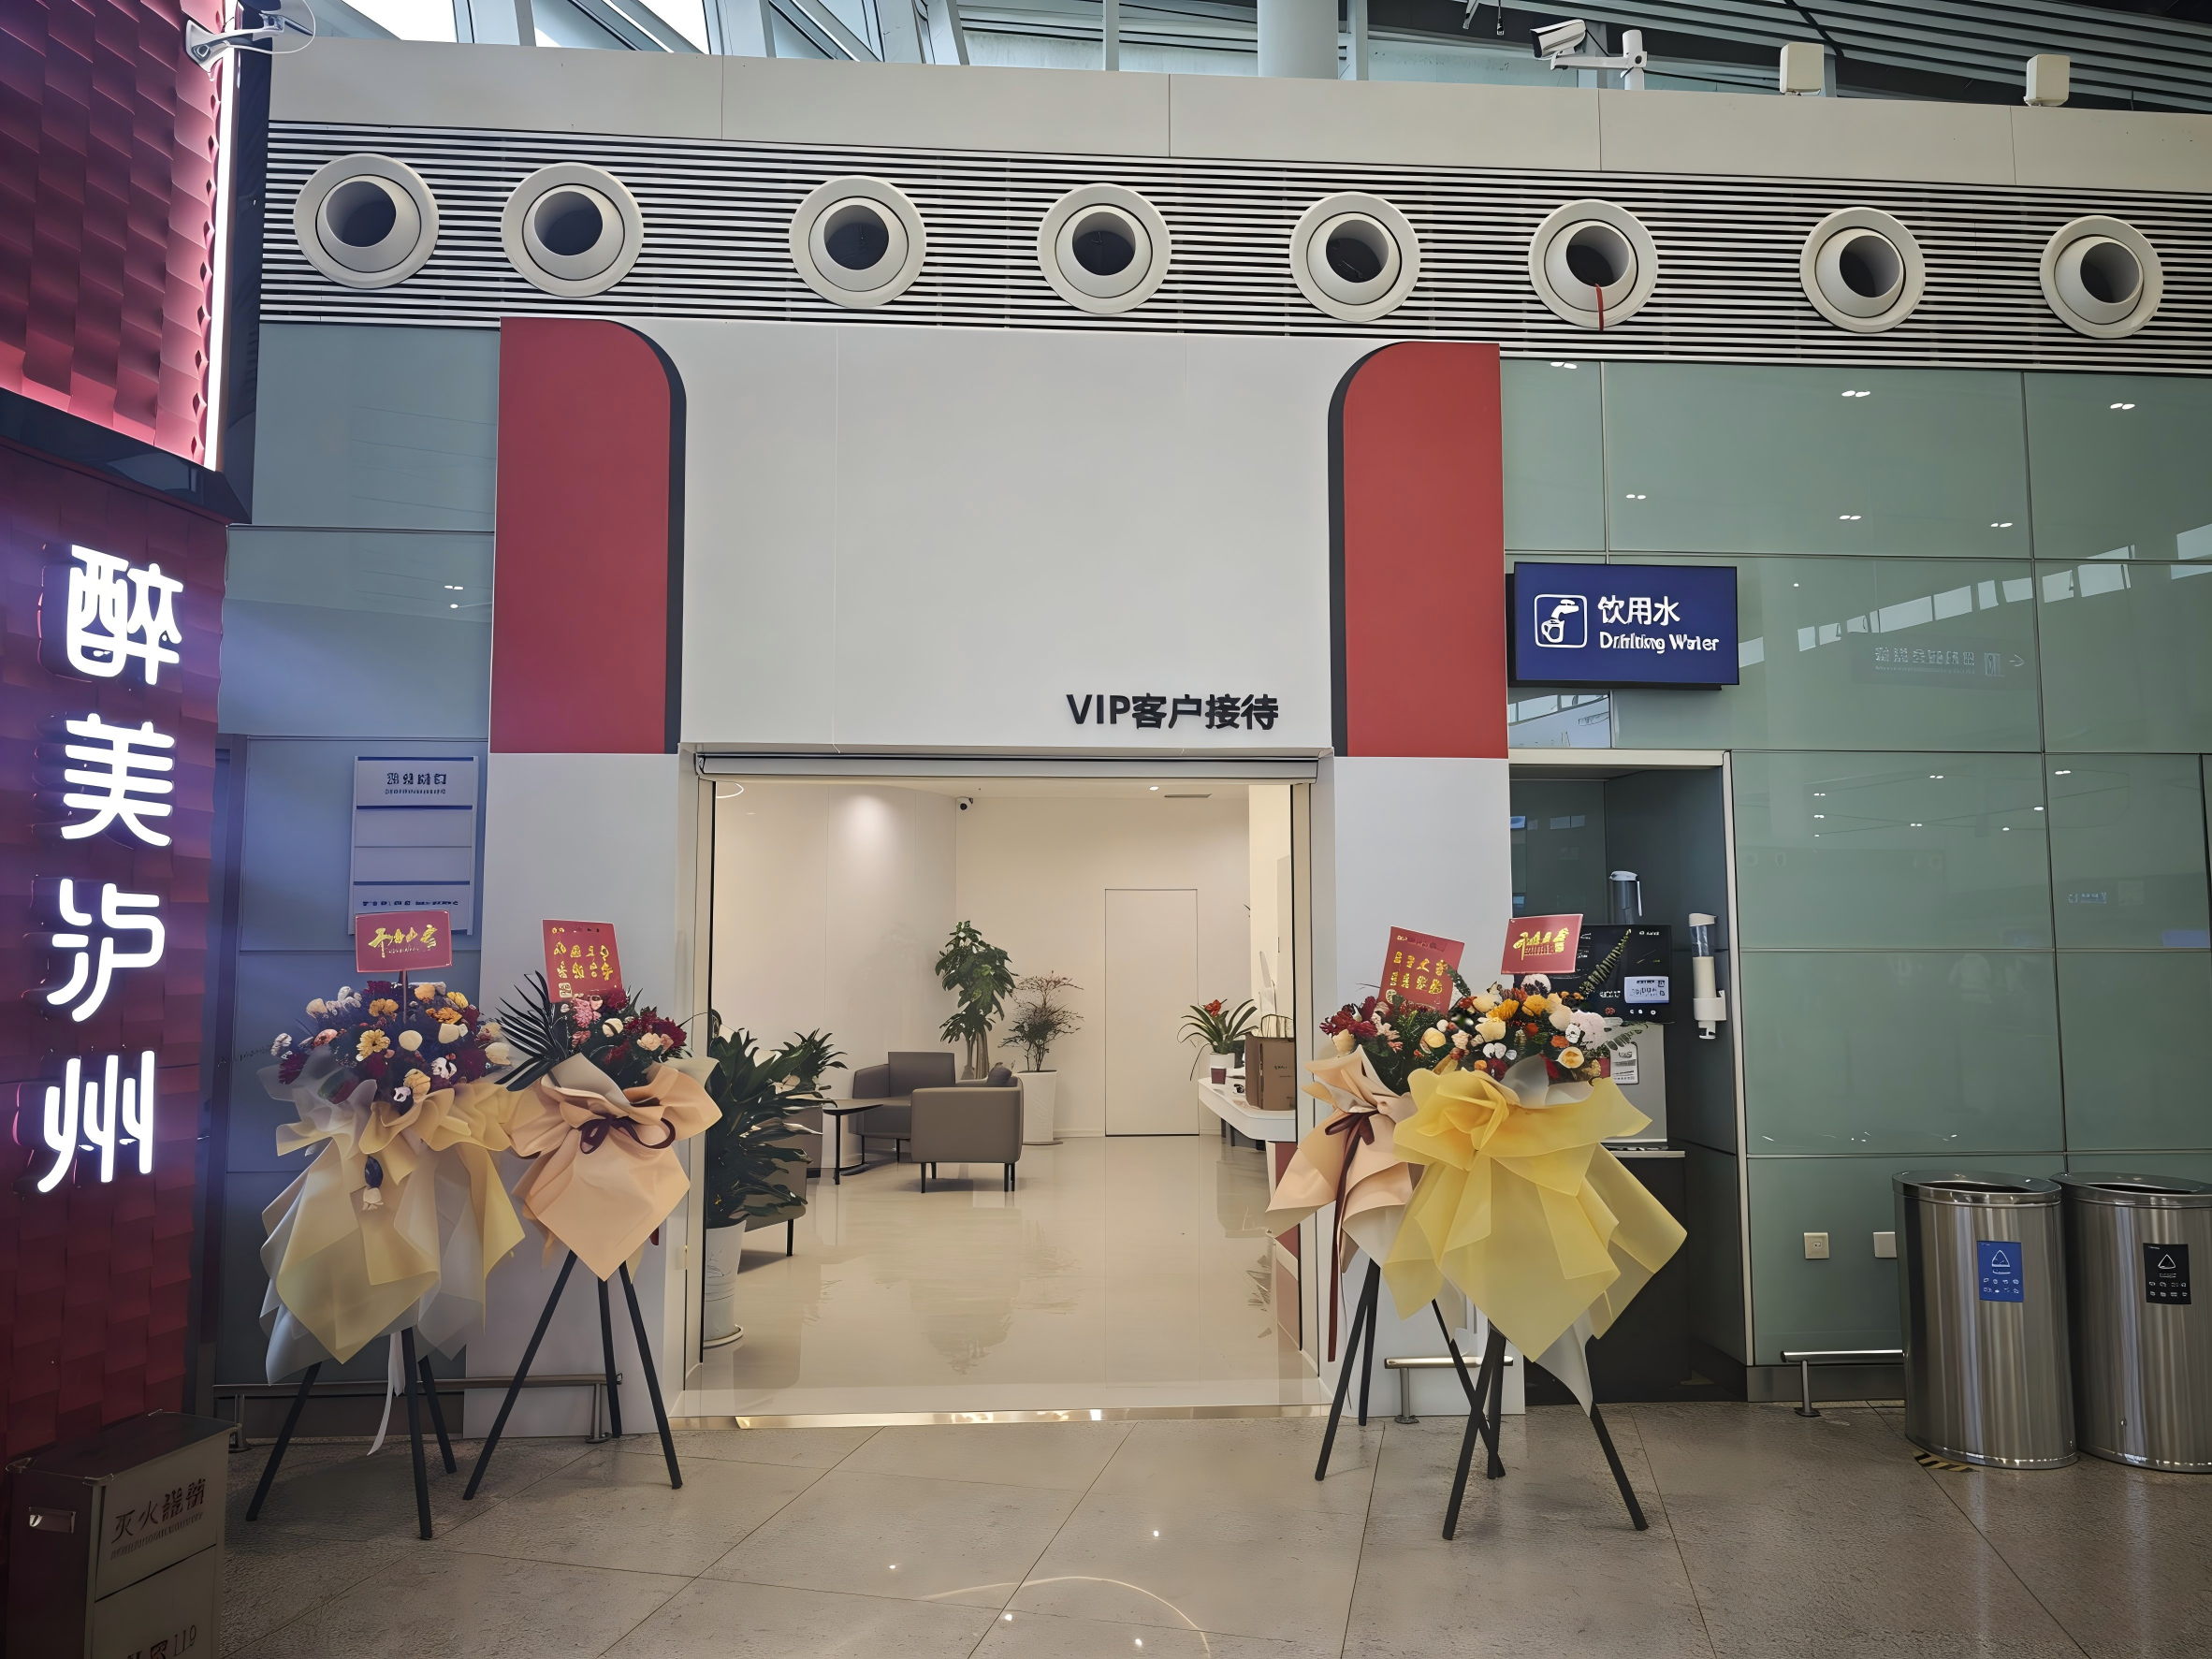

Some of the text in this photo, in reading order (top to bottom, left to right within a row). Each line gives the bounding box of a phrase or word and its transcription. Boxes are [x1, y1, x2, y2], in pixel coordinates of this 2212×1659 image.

[1597, 595, 1681, 626] 饮用水
[1668, 633, 1720, 652] Water
[1066, 692, 1279, 731] VIP客户接待
[38, 545, 184, 1193] 醉美泸州
